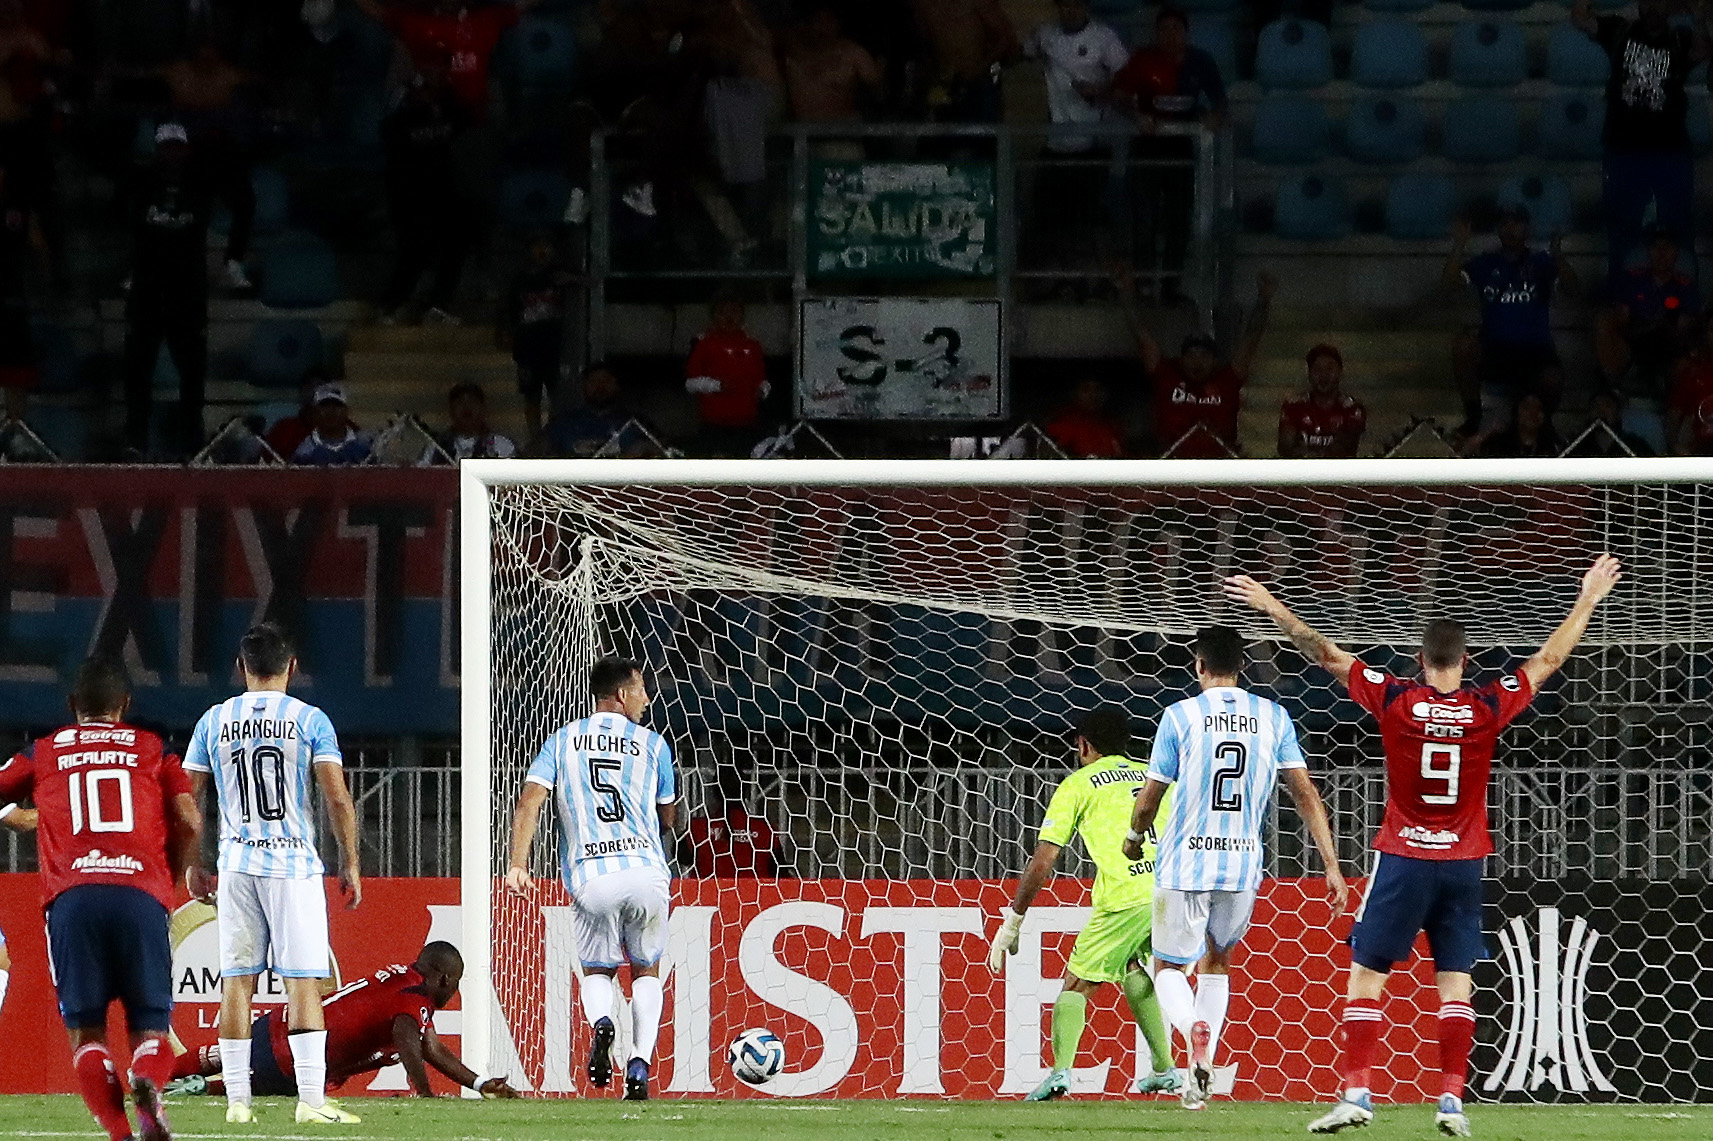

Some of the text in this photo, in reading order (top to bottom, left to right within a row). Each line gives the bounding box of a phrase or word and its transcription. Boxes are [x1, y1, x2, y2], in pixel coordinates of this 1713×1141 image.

[220, 719, 296, 742] ARANGUIZ
[1204, 711, 1258, 734] PIÑERO
[573, 733, 640, 757] VILCHES
[57, 750, 139, 771] RICAURTE
[231, 745, 286, 824] 10
[1211, 741, 1247, 812] 2
[1420, 742, 1461, 805] 9
[68, 768, 135, 836] 10
[588, 758, 625, 823] 5
[584, 839, 623, 857] SCORE
[1188, 836, 1228, 851] SCORE
[1127, 860, 1157, 877] SCO
